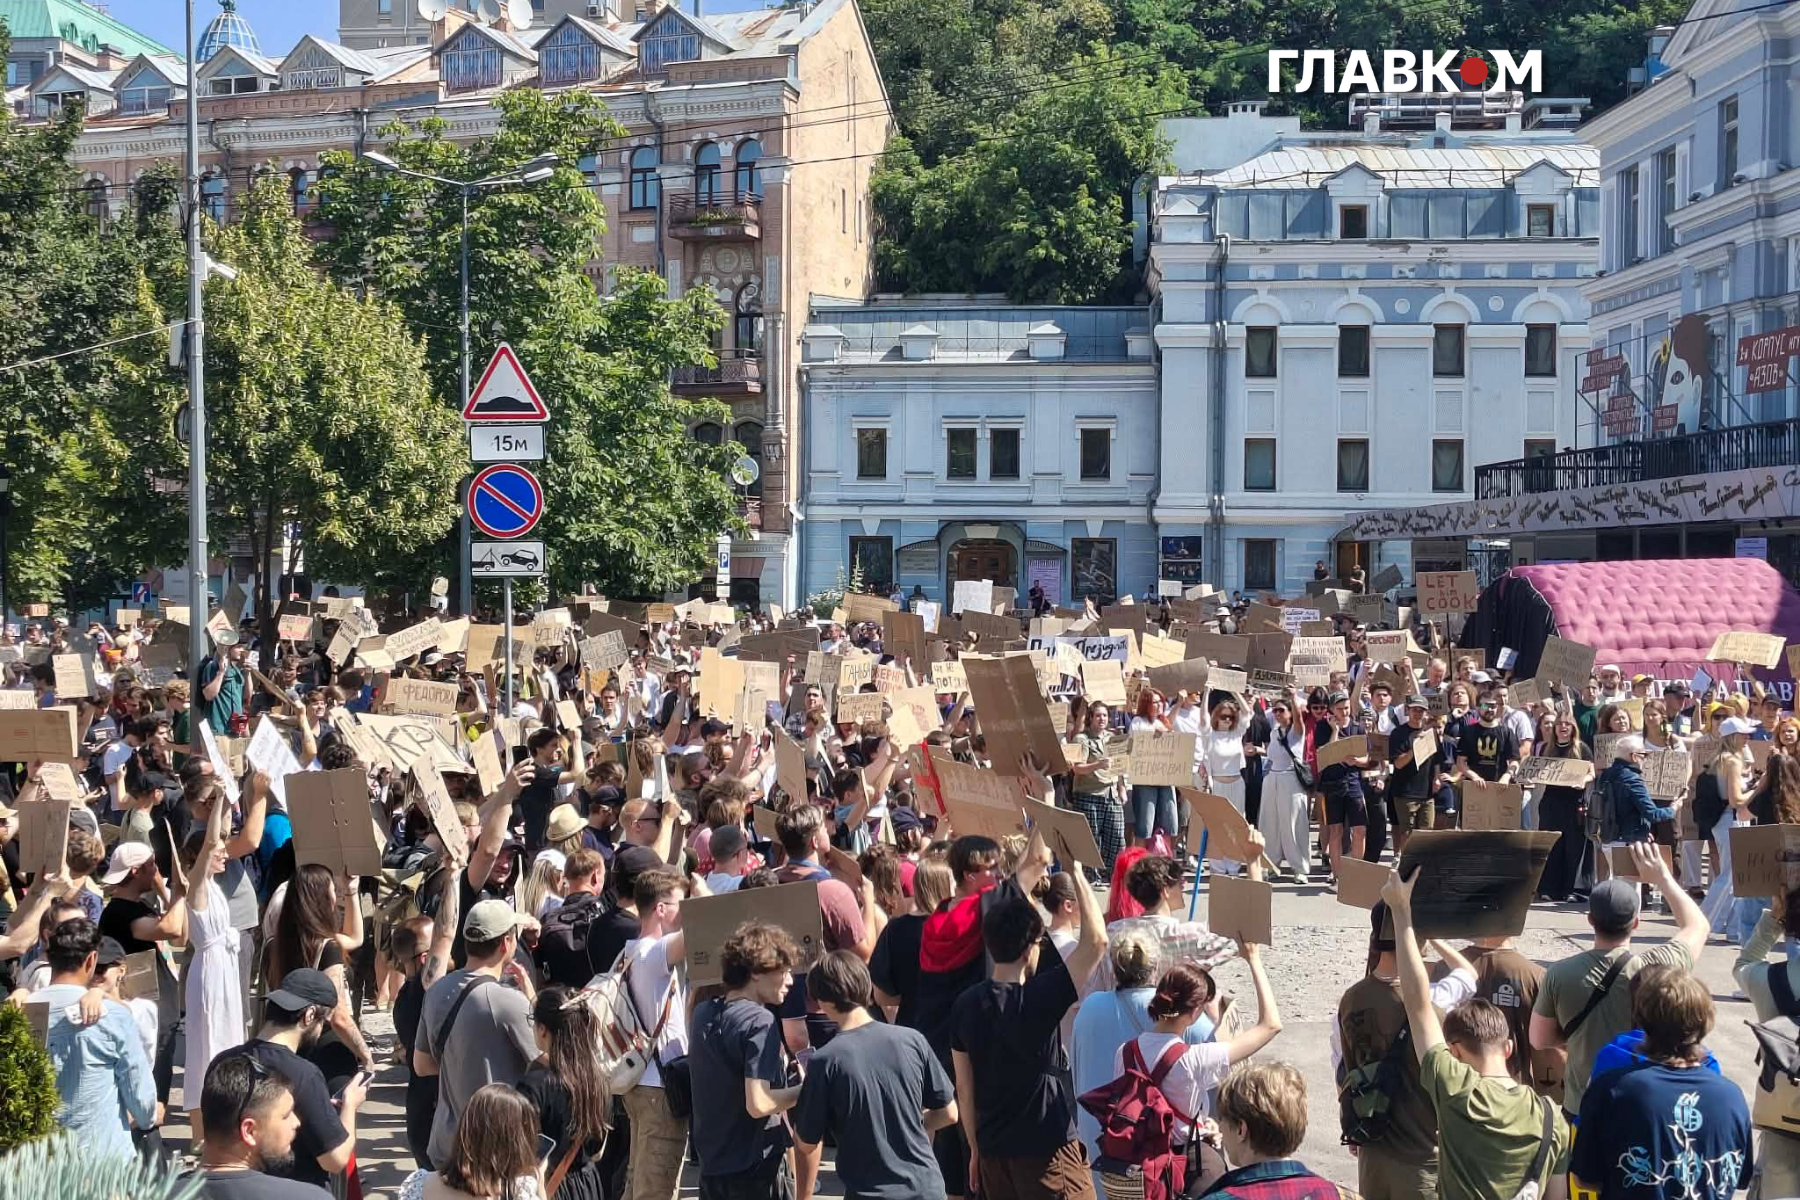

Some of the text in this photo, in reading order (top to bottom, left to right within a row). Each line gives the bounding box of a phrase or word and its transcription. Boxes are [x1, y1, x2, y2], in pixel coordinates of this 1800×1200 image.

[1751, 333, 1786, 361] КОРПУС
[1425, 574, 1459, 589] LET
[1439, 589, 1458, 597] him
[1426, 593, 1475, 610] COOK
[1525, 757, 1541, 767] НЕ
